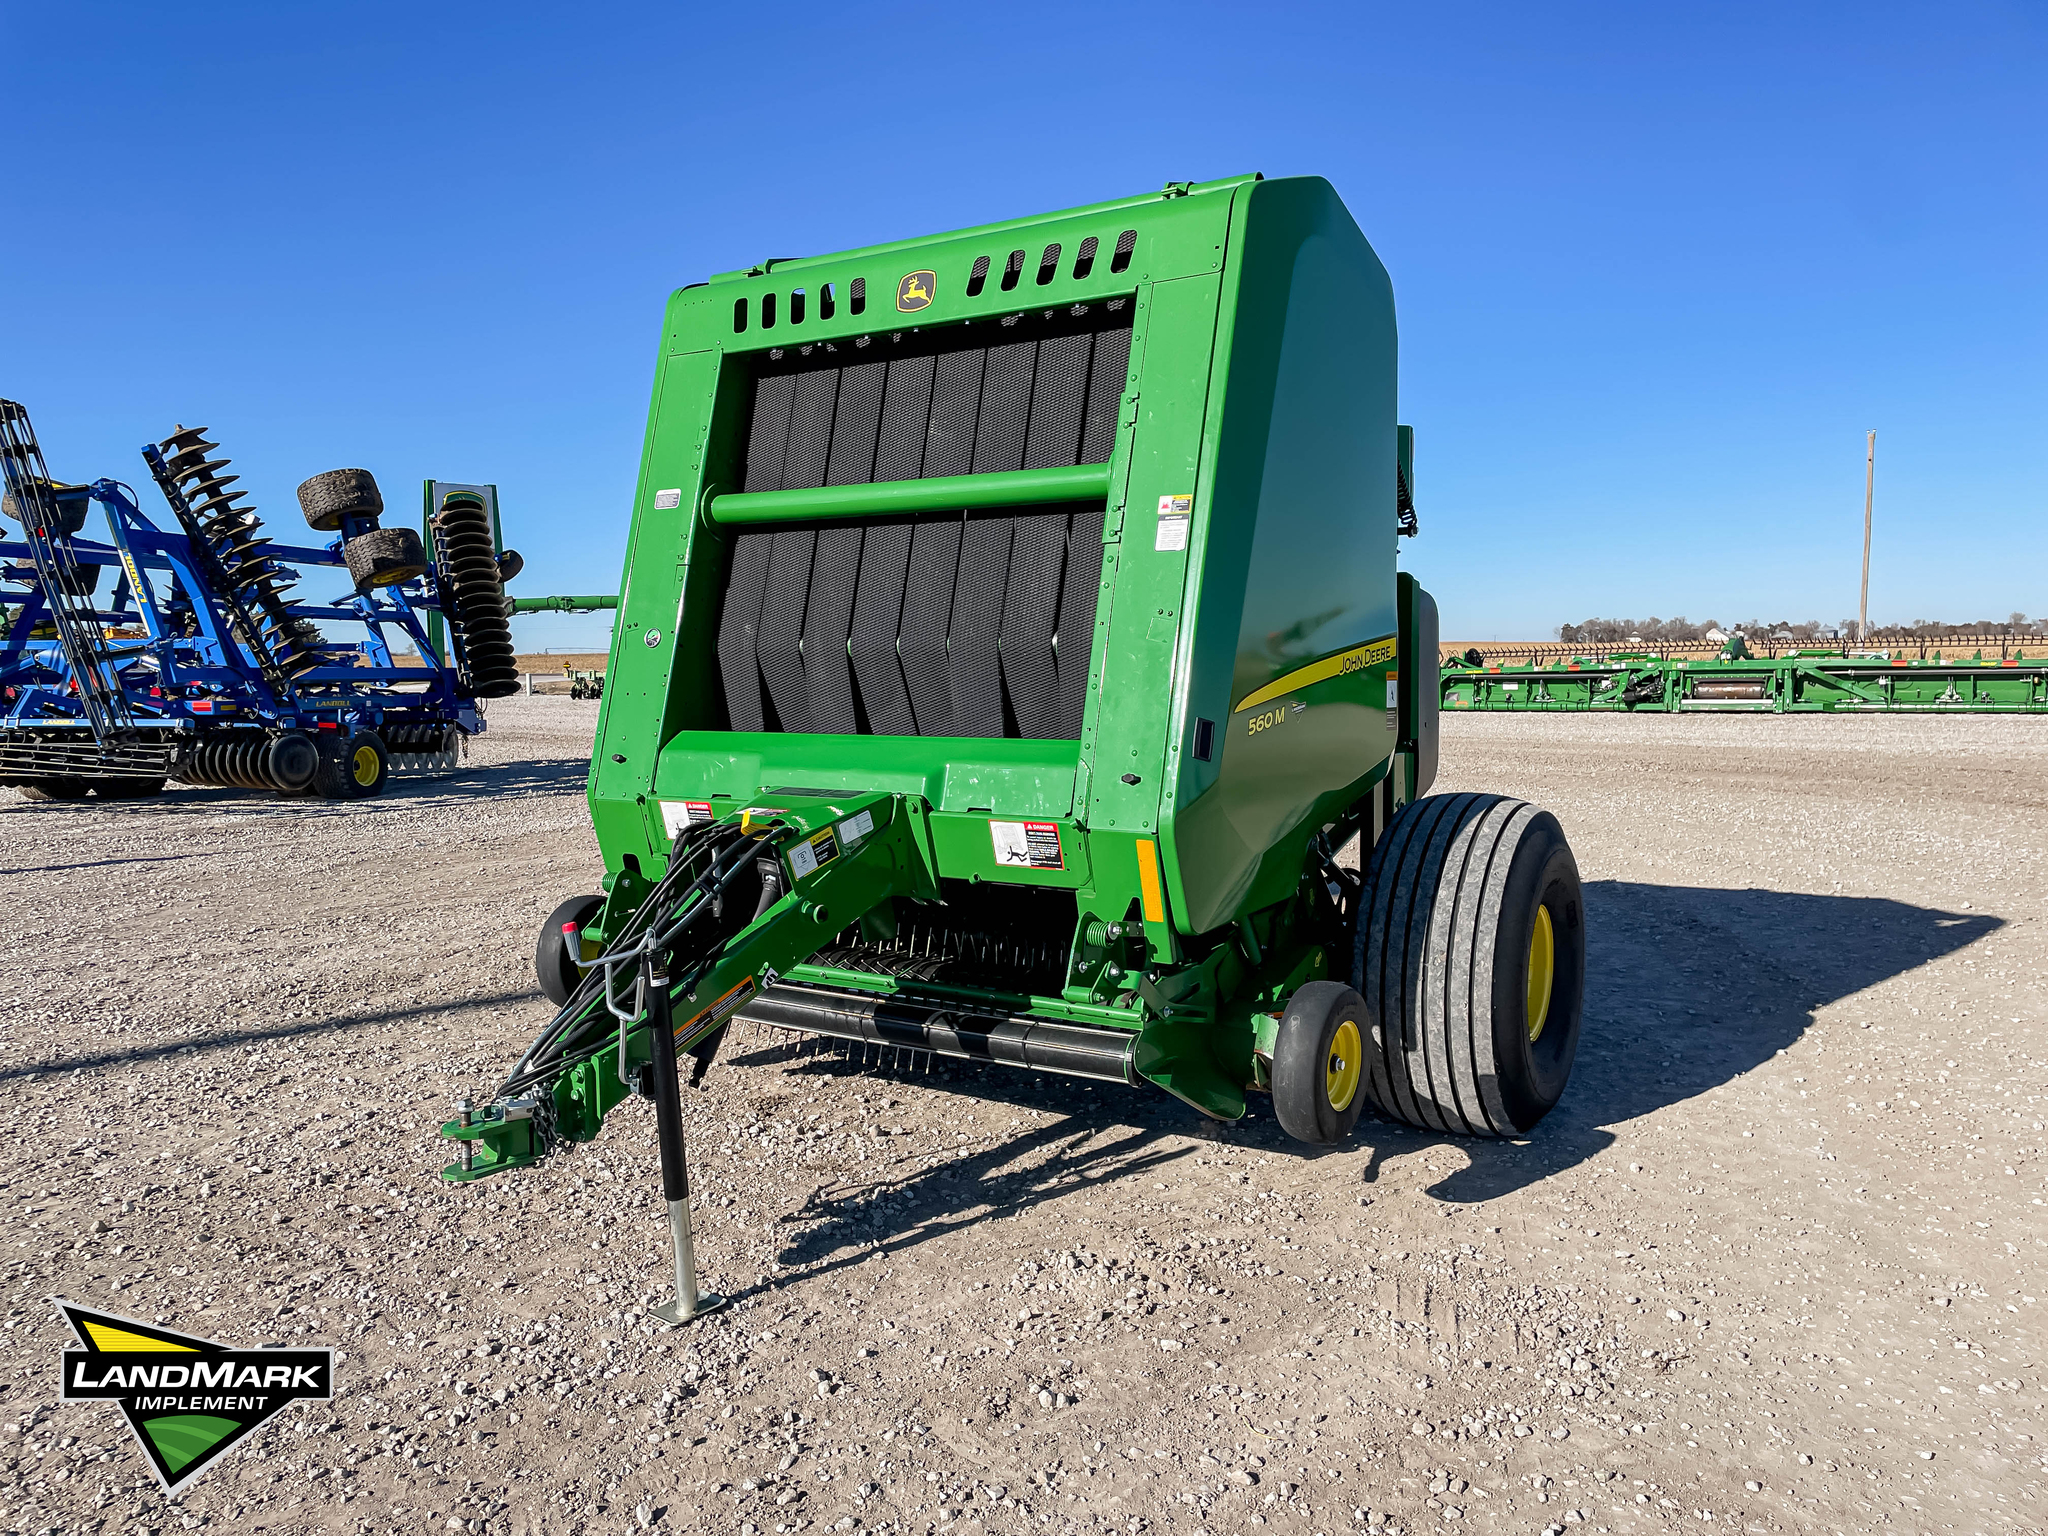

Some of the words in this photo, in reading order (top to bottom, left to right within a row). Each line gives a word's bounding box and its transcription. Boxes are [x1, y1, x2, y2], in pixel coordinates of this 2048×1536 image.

[1340, 654, 1363, 675] JOHN
[1365, 646, 1391, 666] DEERE
[1248, 711, 1273, 736] 560
[1275, 707, 1285, 725] M
